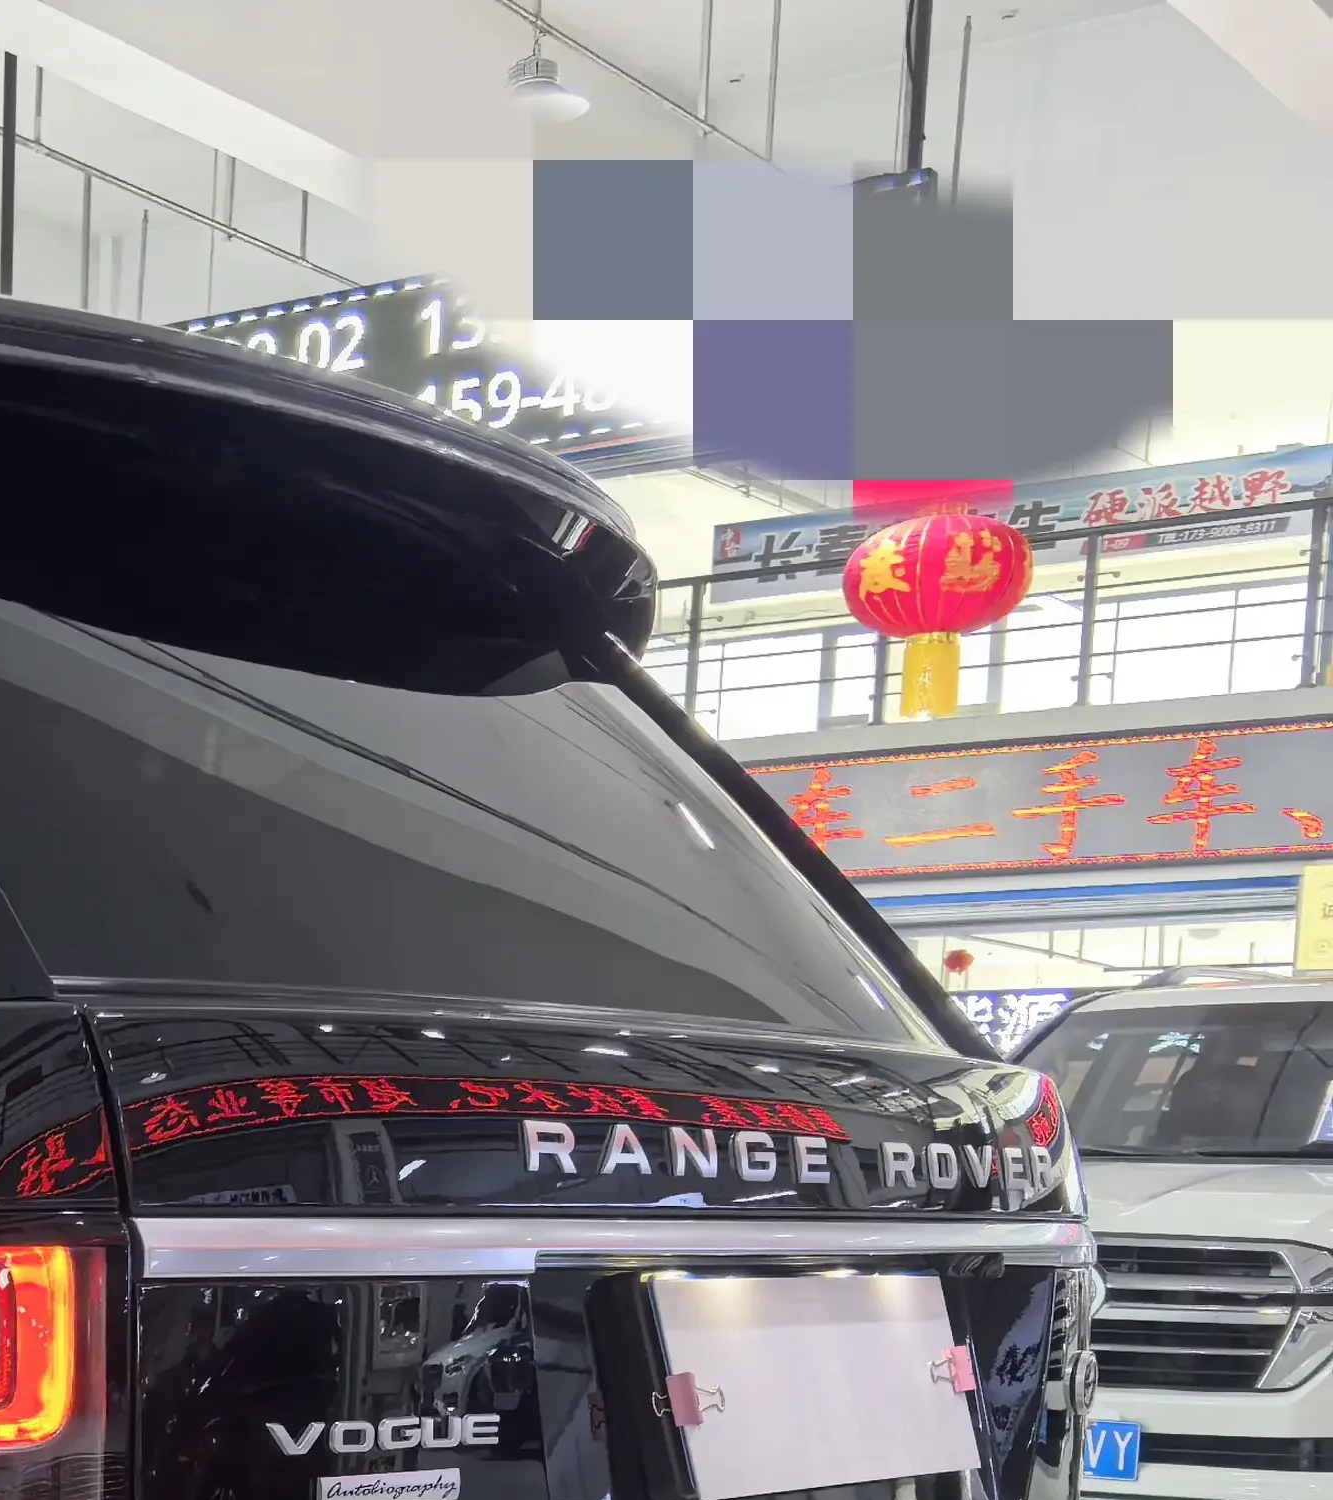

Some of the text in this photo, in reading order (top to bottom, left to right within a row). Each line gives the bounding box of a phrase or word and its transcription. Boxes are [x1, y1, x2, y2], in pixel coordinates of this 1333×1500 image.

[1084, 469, 1290, 527] 硬派越野
[522, 1119, 1054, 1191] RANGE ROVER
[265, 1412, 501, 1456] VOGUE
[326, 1474, 457, 1500] Autobiography
